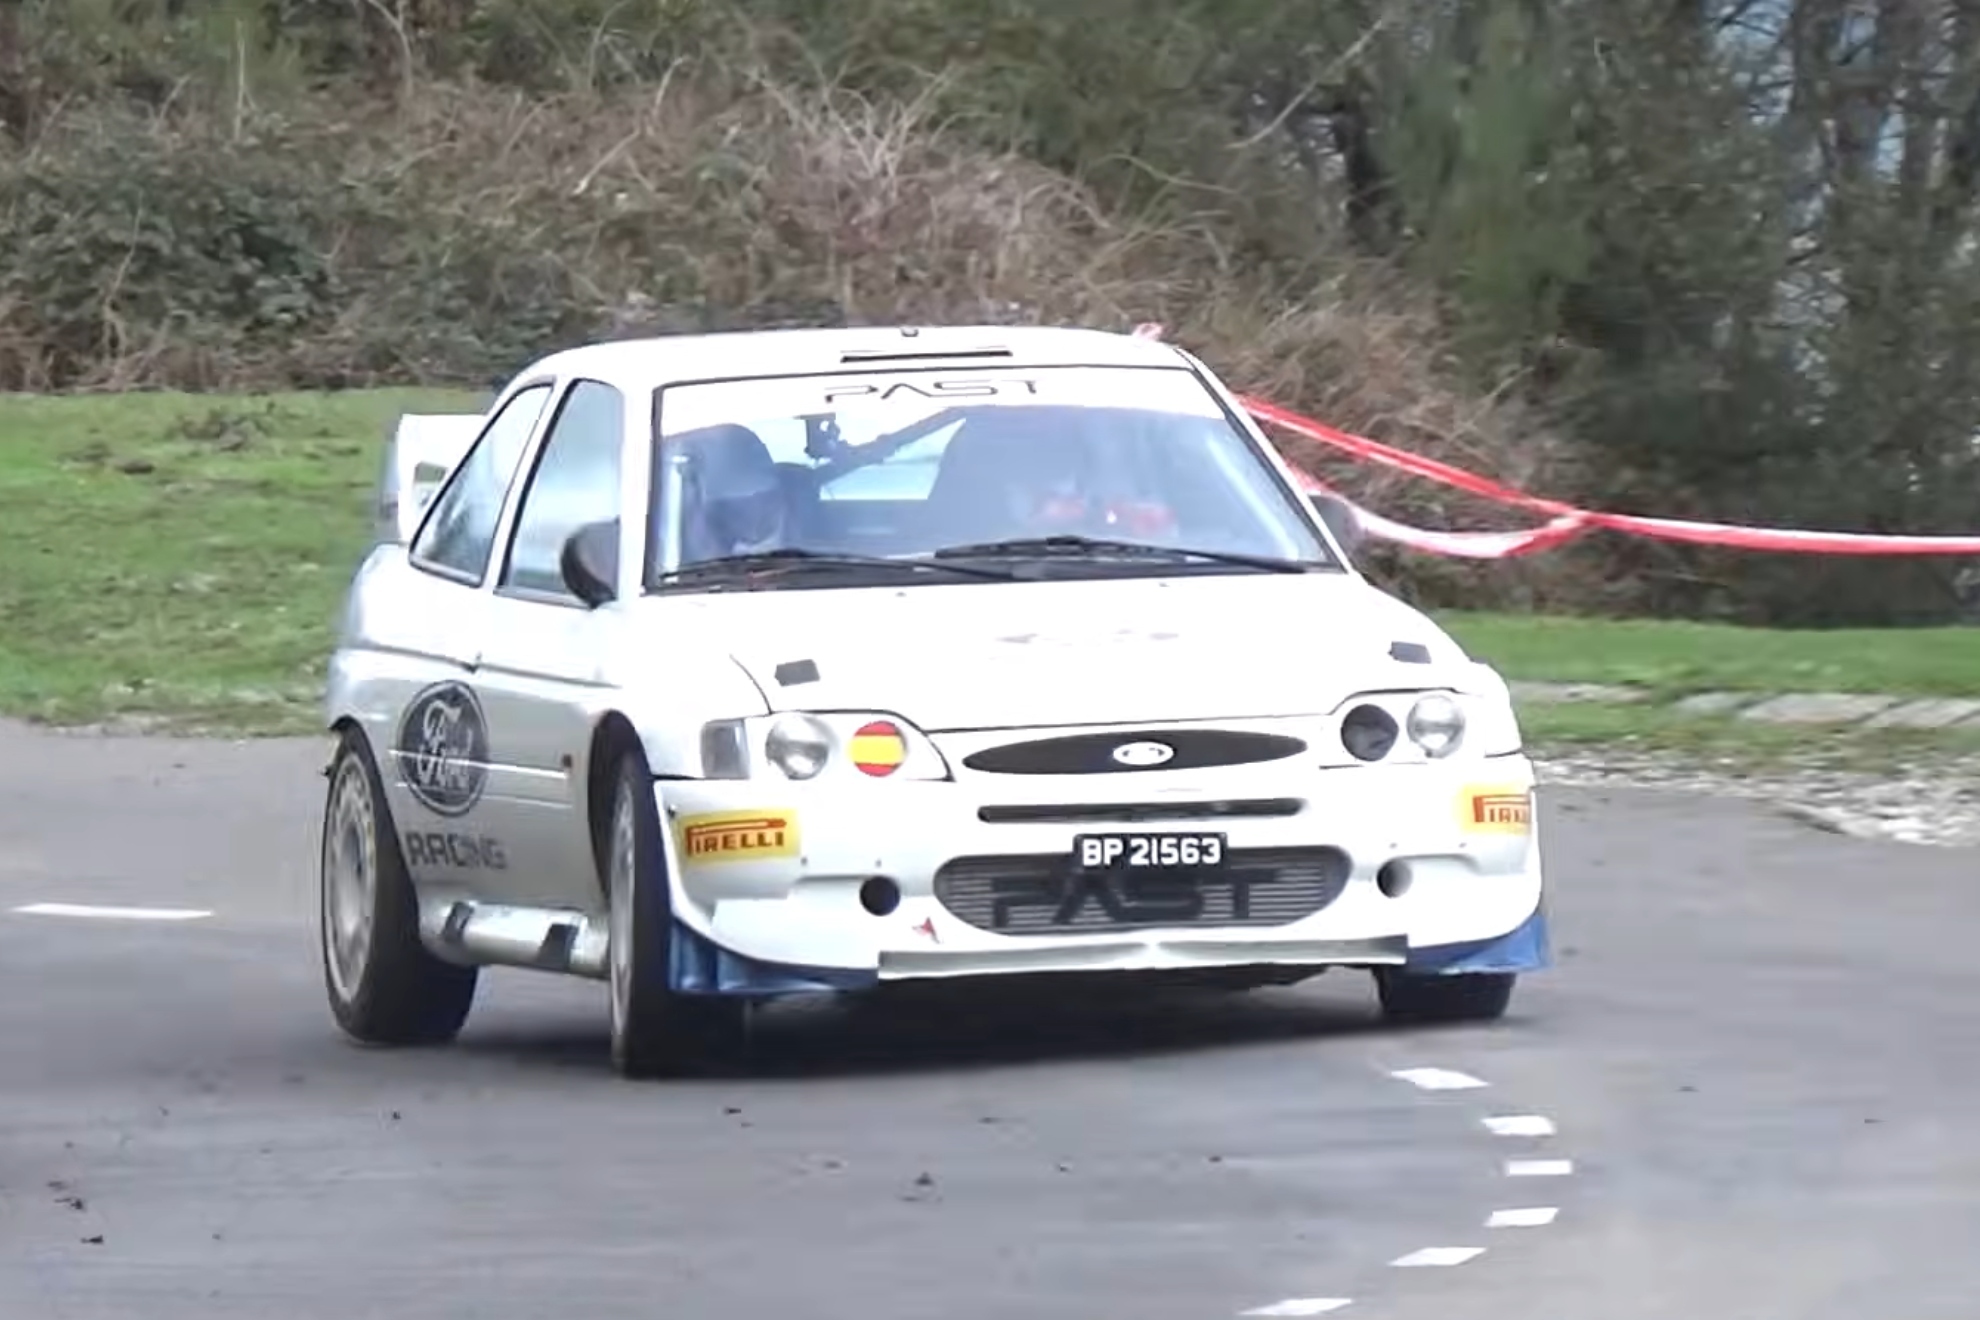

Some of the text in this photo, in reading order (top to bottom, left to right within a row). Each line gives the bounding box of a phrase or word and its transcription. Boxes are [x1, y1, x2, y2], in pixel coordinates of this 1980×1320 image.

[685, 818, 787, 857] PIRELLI
[1082, 836, 1221, 866] BP 21563
